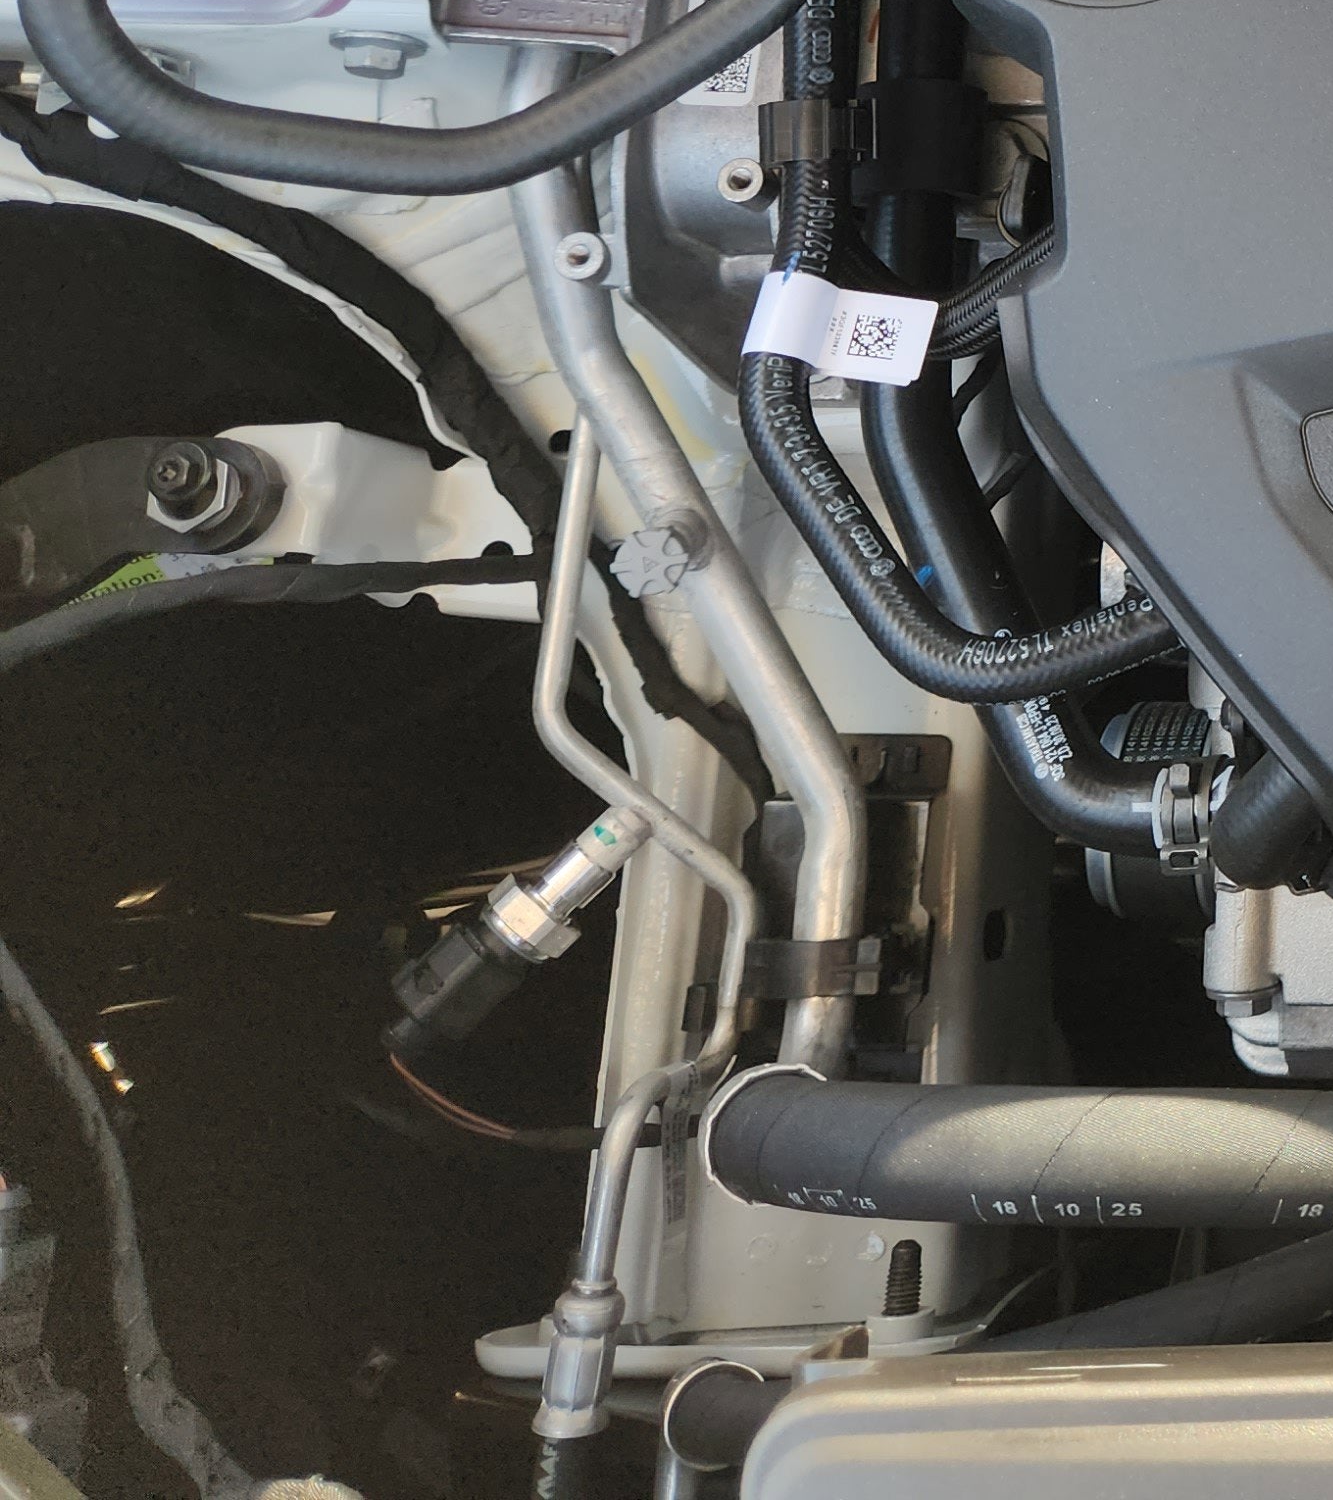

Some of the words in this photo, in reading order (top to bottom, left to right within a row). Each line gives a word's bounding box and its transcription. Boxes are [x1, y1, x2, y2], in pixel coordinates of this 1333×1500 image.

[801, 460, 843, 498] VRT
[825, 495, 863, 525] DE
[1061, 597, 1155, 638] Pentaflex
[819, 1195, 838, 1208] 10
[992, 1200, 1018, 1216] 18
[1054, 1202, 1081, 1217] 10
[1111, 1202, 1143, 1217] 25
[1297, 1203, 1325, 1218] 18
